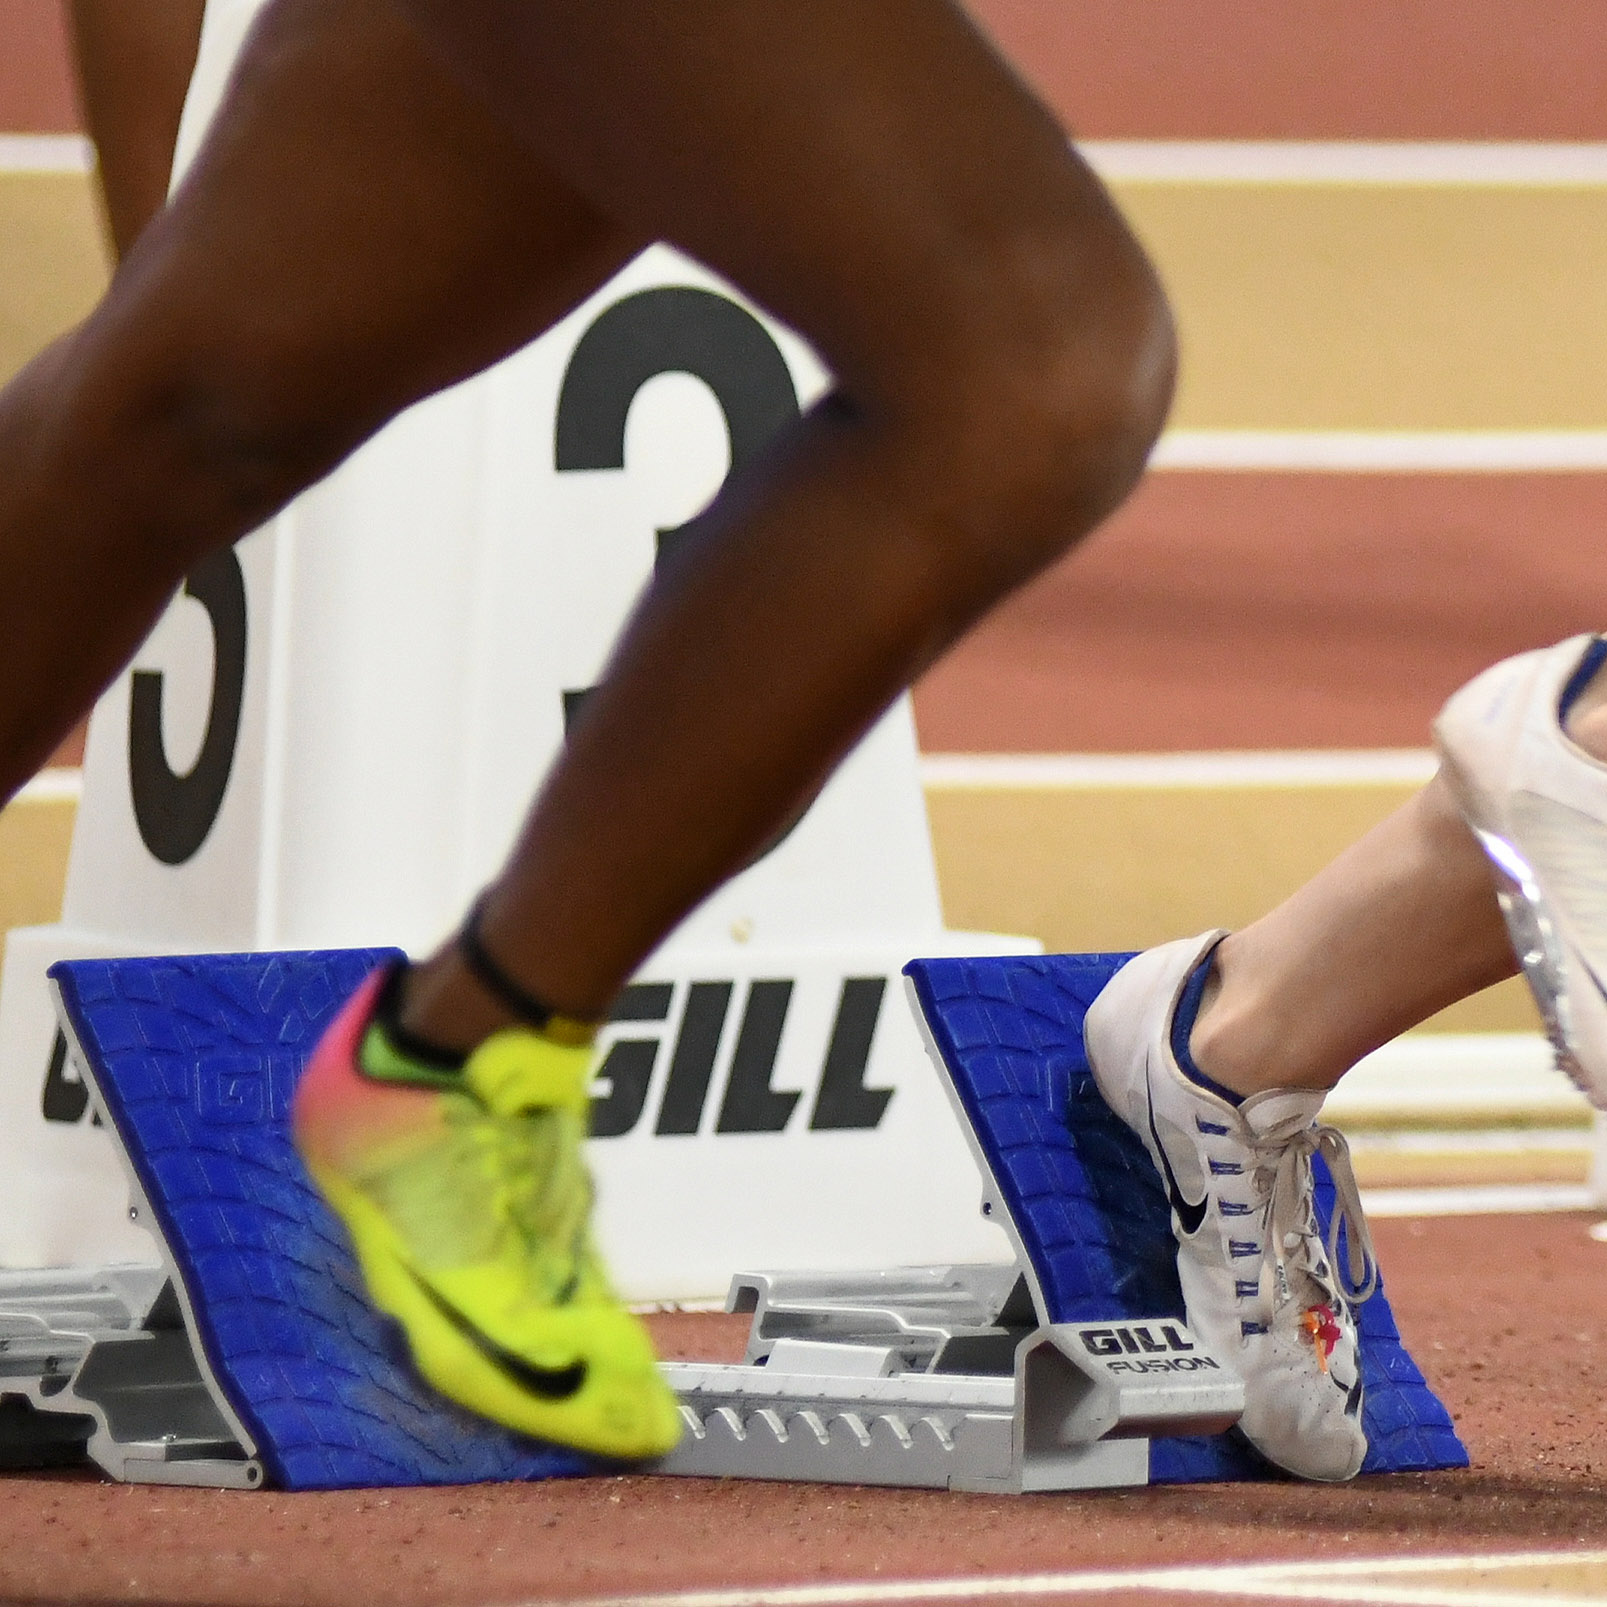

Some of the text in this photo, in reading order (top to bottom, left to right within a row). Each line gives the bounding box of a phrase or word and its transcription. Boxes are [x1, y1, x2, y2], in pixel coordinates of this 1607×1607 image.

[588, 977, 897, 1137] GILL
[1078, 1325, 1194, 1356] GILL
[1106, 1355, 1221, 1375] FUSION
